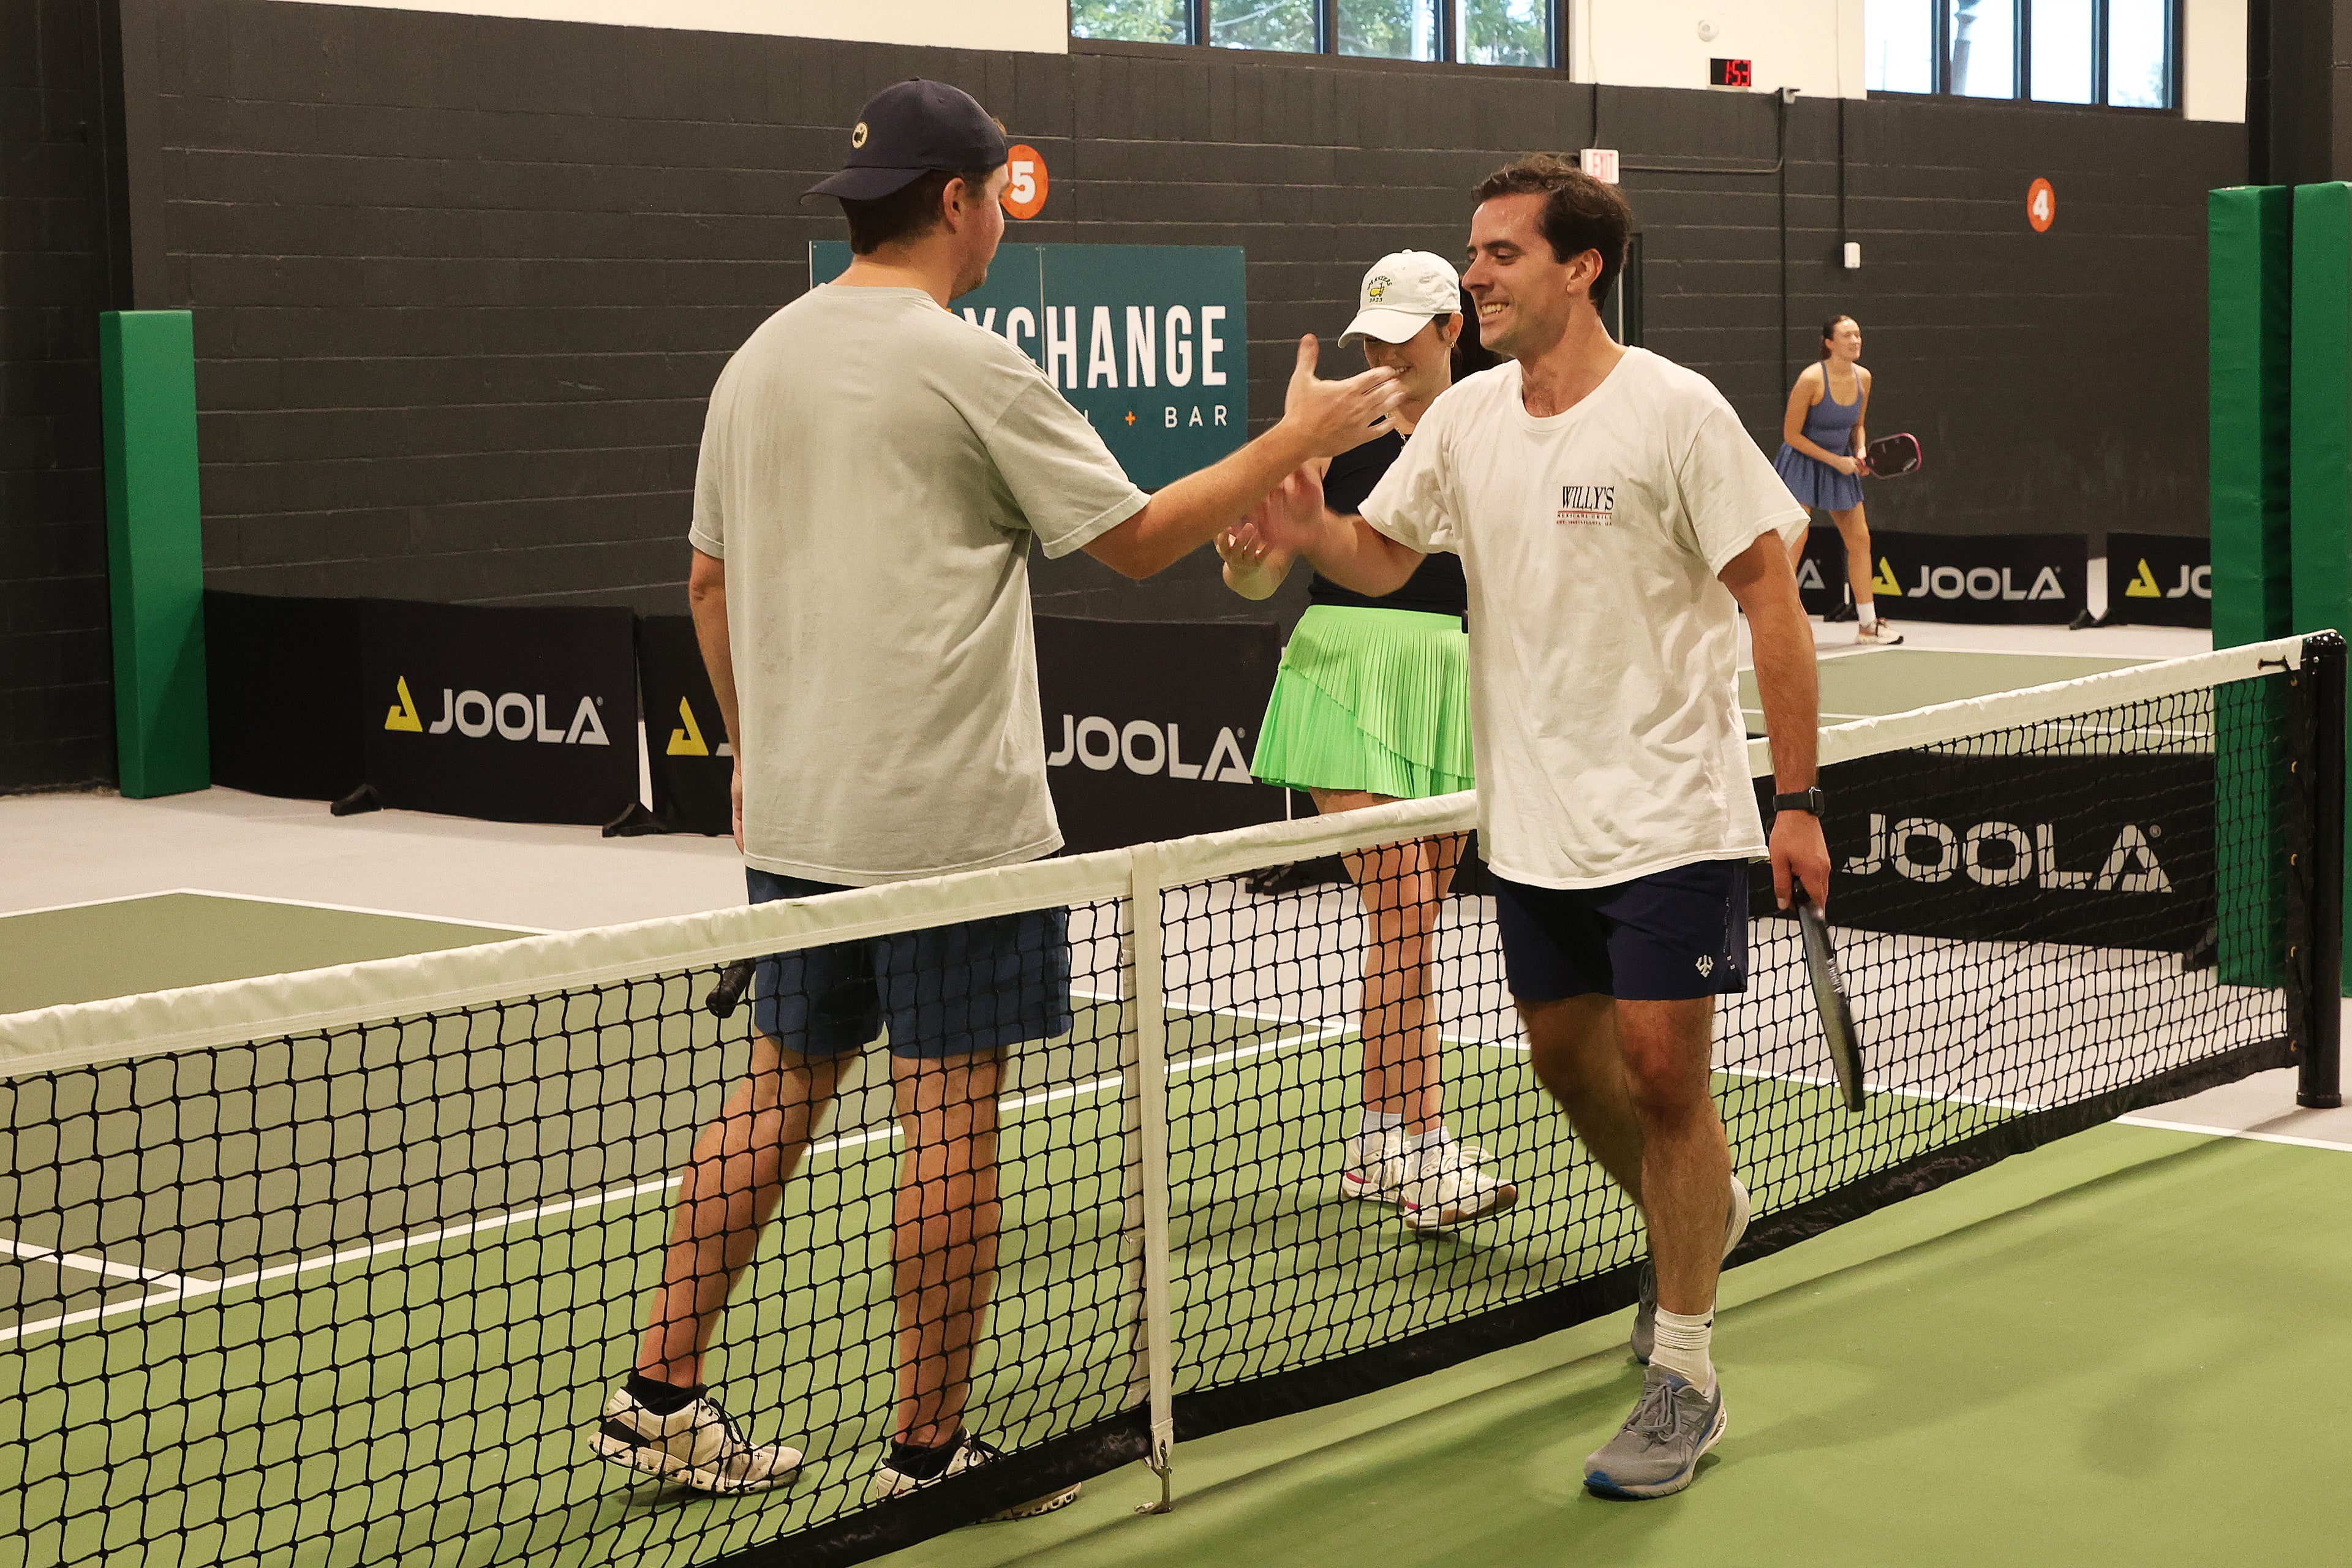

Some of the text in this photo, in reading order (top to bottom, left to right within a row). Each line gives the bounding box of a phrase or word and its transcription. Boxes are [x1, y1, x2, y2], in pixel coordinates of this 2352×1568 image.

[1011, 160, 1036, 204] 5
[1593, 153, 1613, 179] EXIT
[2032, 189, 2049, 221] 4
[963, 305, 1227, 389] CHANGE
[1165, 405, 1227, 428] BAR
[1562, 486, 1615, 512] WILLY'S
[1907, 565, 2065, 600] JOOLA
[429, 688, 610, 745] JOOLA
[1047, 714, 1254, 785] JOOLA
[1842, 812, 2173, 894] JOOLA
